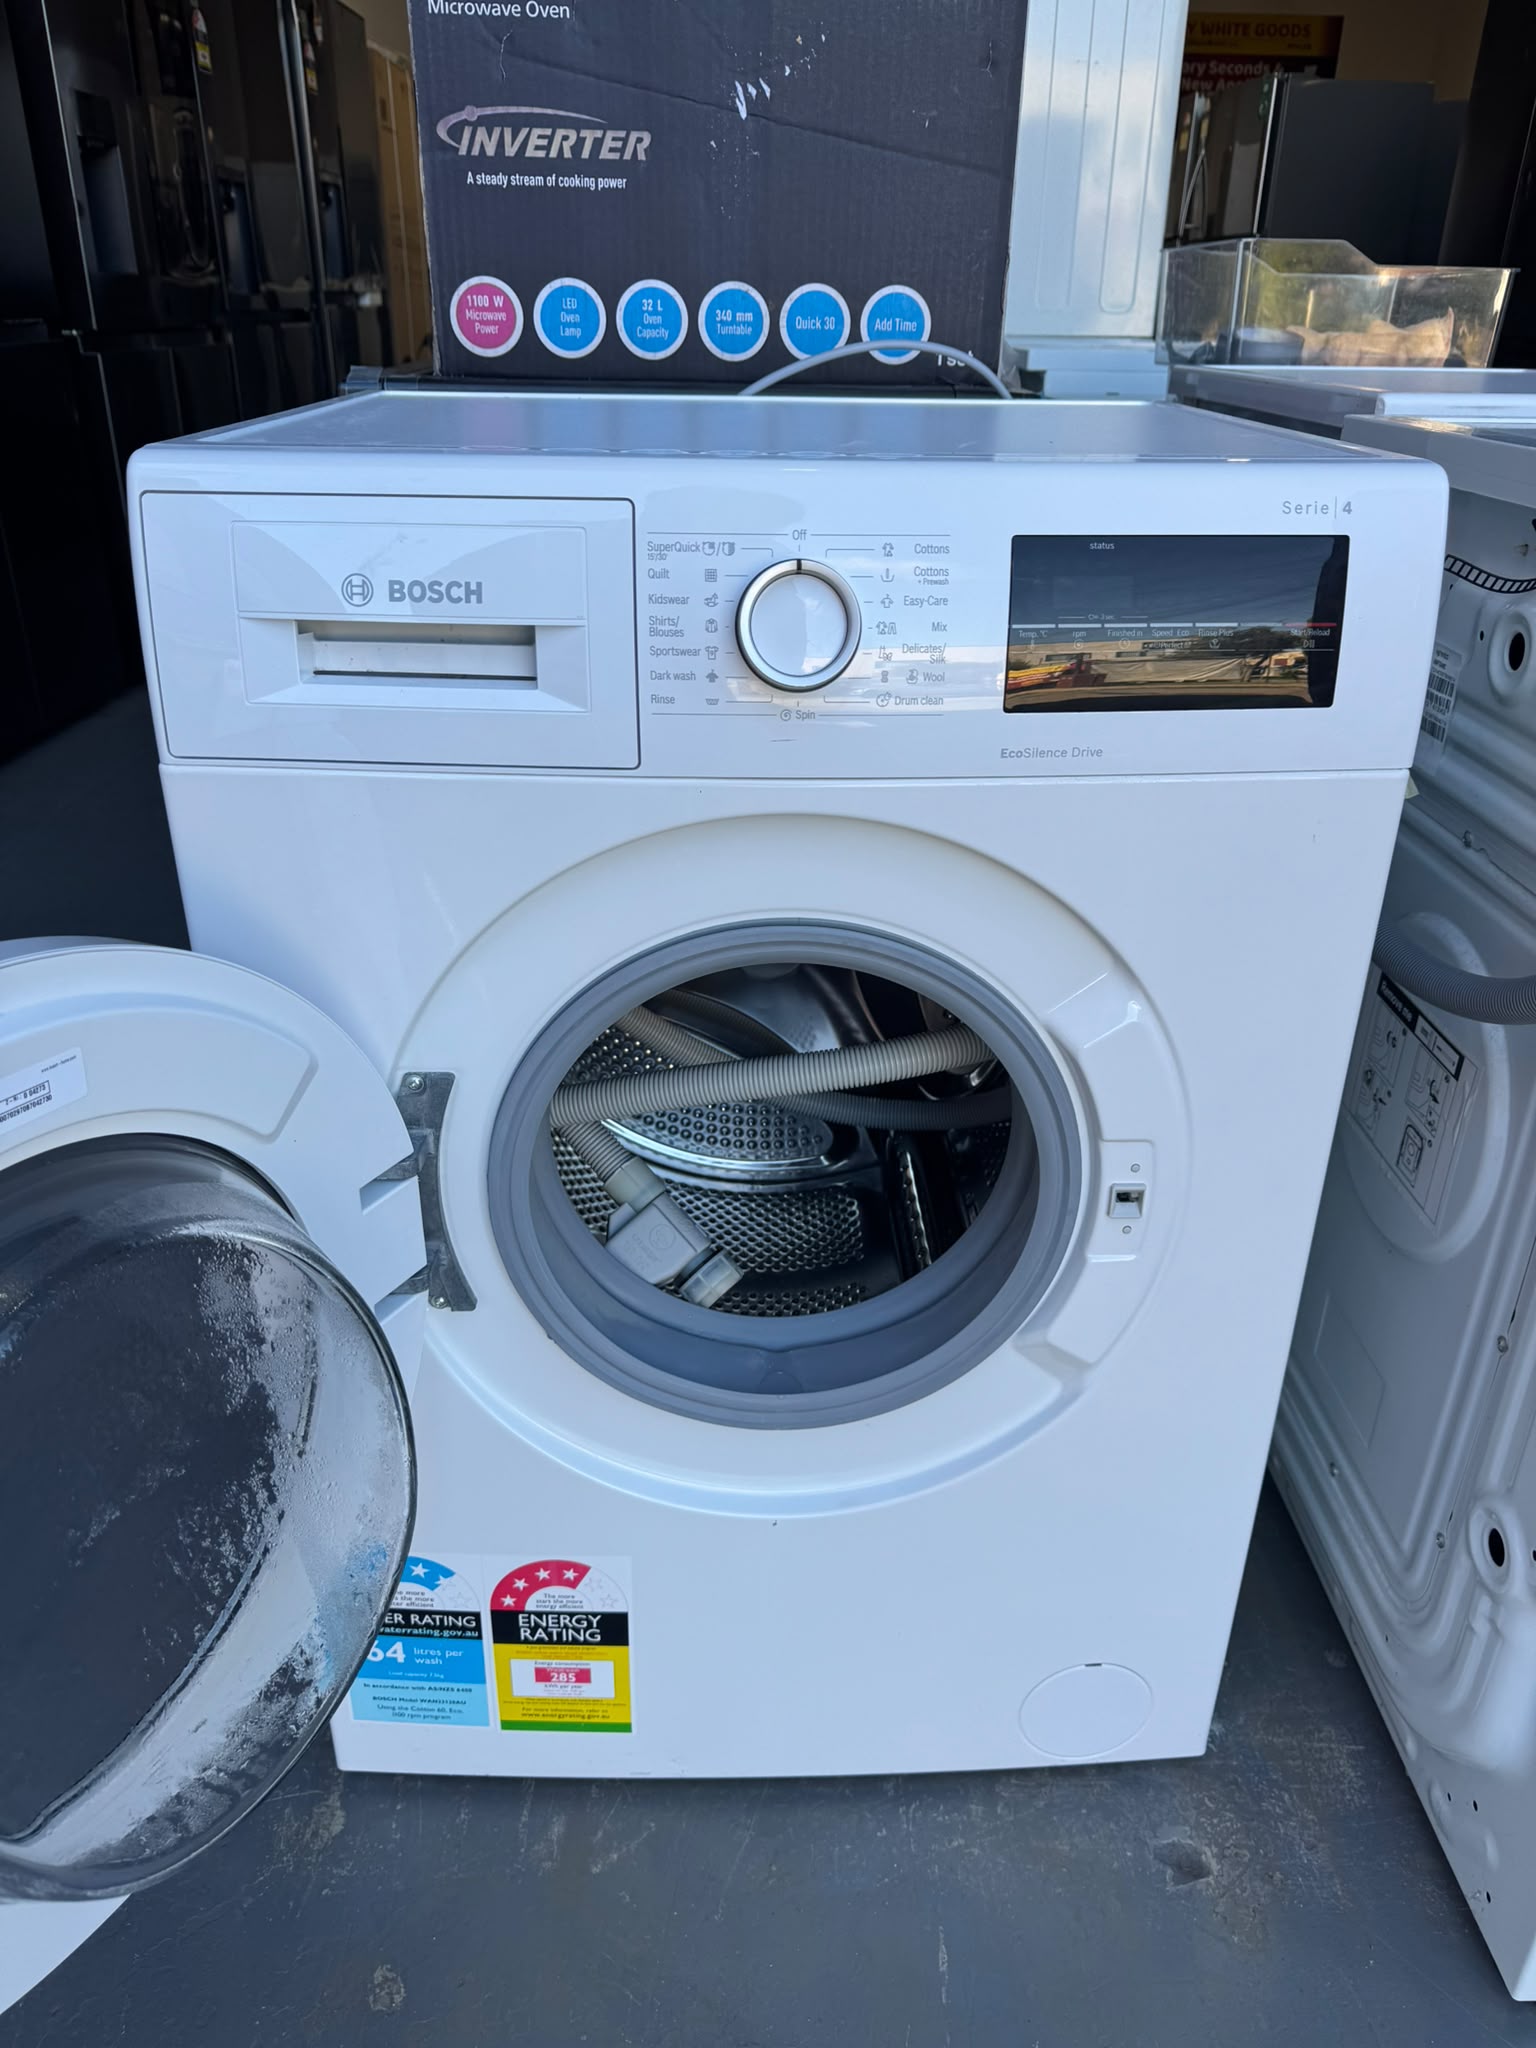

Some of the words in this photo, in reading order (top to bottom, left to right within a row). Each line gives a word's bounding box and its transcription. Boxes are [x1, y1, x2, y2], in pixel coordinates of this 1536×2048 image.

[427, 0, 521, 17] Microwave
[525, 1, 571, 19] Oven
[1201, 22, 1250, 37] WHITE
[1254, 23, 1312, 38] GOODS
[458, 125, 652, 161] INVERTER
[466, 171, 475, 185] A
[476, 172, 508, 189] steady
[510, 173, 545, 187] stream
[546, 174, 556, 188] of
[558, 174, 596, 191] cooking
[597, 177, 627, 191] power
[466, 295, 490, 308] 1100
[493, 295, 504, 308] W
[562, 298, 578, 310] LED
[641, 299, 654, 311] 32
[657, 299, 664, 311] L
[465, 308, 507, 322] Microwave
[560, 311, 581, 323] Oven
[643, 312, 663, 325] Oven
[715, 309, 733, 322] 340
[735, 311, 754, 322] mm
[474, 322, 499, 335] Power
[716, 322, 753, 335] Turntable
[795, 316, 822, 331] Quick
[824, 317, 836, 331] 30
[874, 317, 893, 331] Add
[895, 318, 918, 332] Time
[560, 325, 582, 338] Lamp
[636, 325, 669, 340] Capacity
[1281, 500, 1330, 515] Serie
[1341, 500, 1353, 515] 4
[791, 529, 807, 541] Off
[647, 541, 701, 554] SuperQuick
[913, 543, 950, 554] Cottons
[1089, 541, 1115, 550] status
[647, 568, 670, 580] Quilt
[913, 566, 950, 577] Cottons
[923, 577, 950, 586] Prewash
[388, 579, 483, 604] BOSCH
[648, 594, 690, 605] Kidswear
[903, 595, 949, 608] Easy-Care
[648, 615, 680, 628] Shirts/
[931, 622, 948, 632] Mix
[649, 626, 685, 638] Blouses
[1018, 630, 1039, 639] Temp.
[1072, 631, 1087, 639] rpm
[1107, 629, 1135, 638] Finished
[1151, 629, 1173, 638] Speed
[1176, 629, 1191, 637] Eco
[1198, 628, 1218, 637] Rinse
[1218, 628, 1234, 637] Plus
[1290, 628, 1331, 637] Start/Reload
[649, 645, 701, 658] Sportswear
[901, 643, 946, 655] Delicates/
[929, 654, 946, 665] Silk
[650, 670, 672, 681] Dark
[673, 670, 697, 681] wash
[922, 671, 945, 682] Wool
[650, 694, 676, 705] Rinse
[894, 695, 918, 706] Drum
[920, 695, 944, 706] clean
[795, 709, 816, 721] Spin
[1000, 747, 1068, 760] EcoSilence
[1071, 746, 1104, 759] Drive
[410, 1613, 477, 1628] RATING
[518, 1613, 602, 1628] ENERGY
[520, 1628, 602, 1642] RATING
[367, 1640, 406, 1664] 64
[413, 1647, 442, 1656] litres
[445, 1650, 464, 1658] per
[414, 1656, 443, 1665] wash
[550, 1672, 577, 1682] 285
